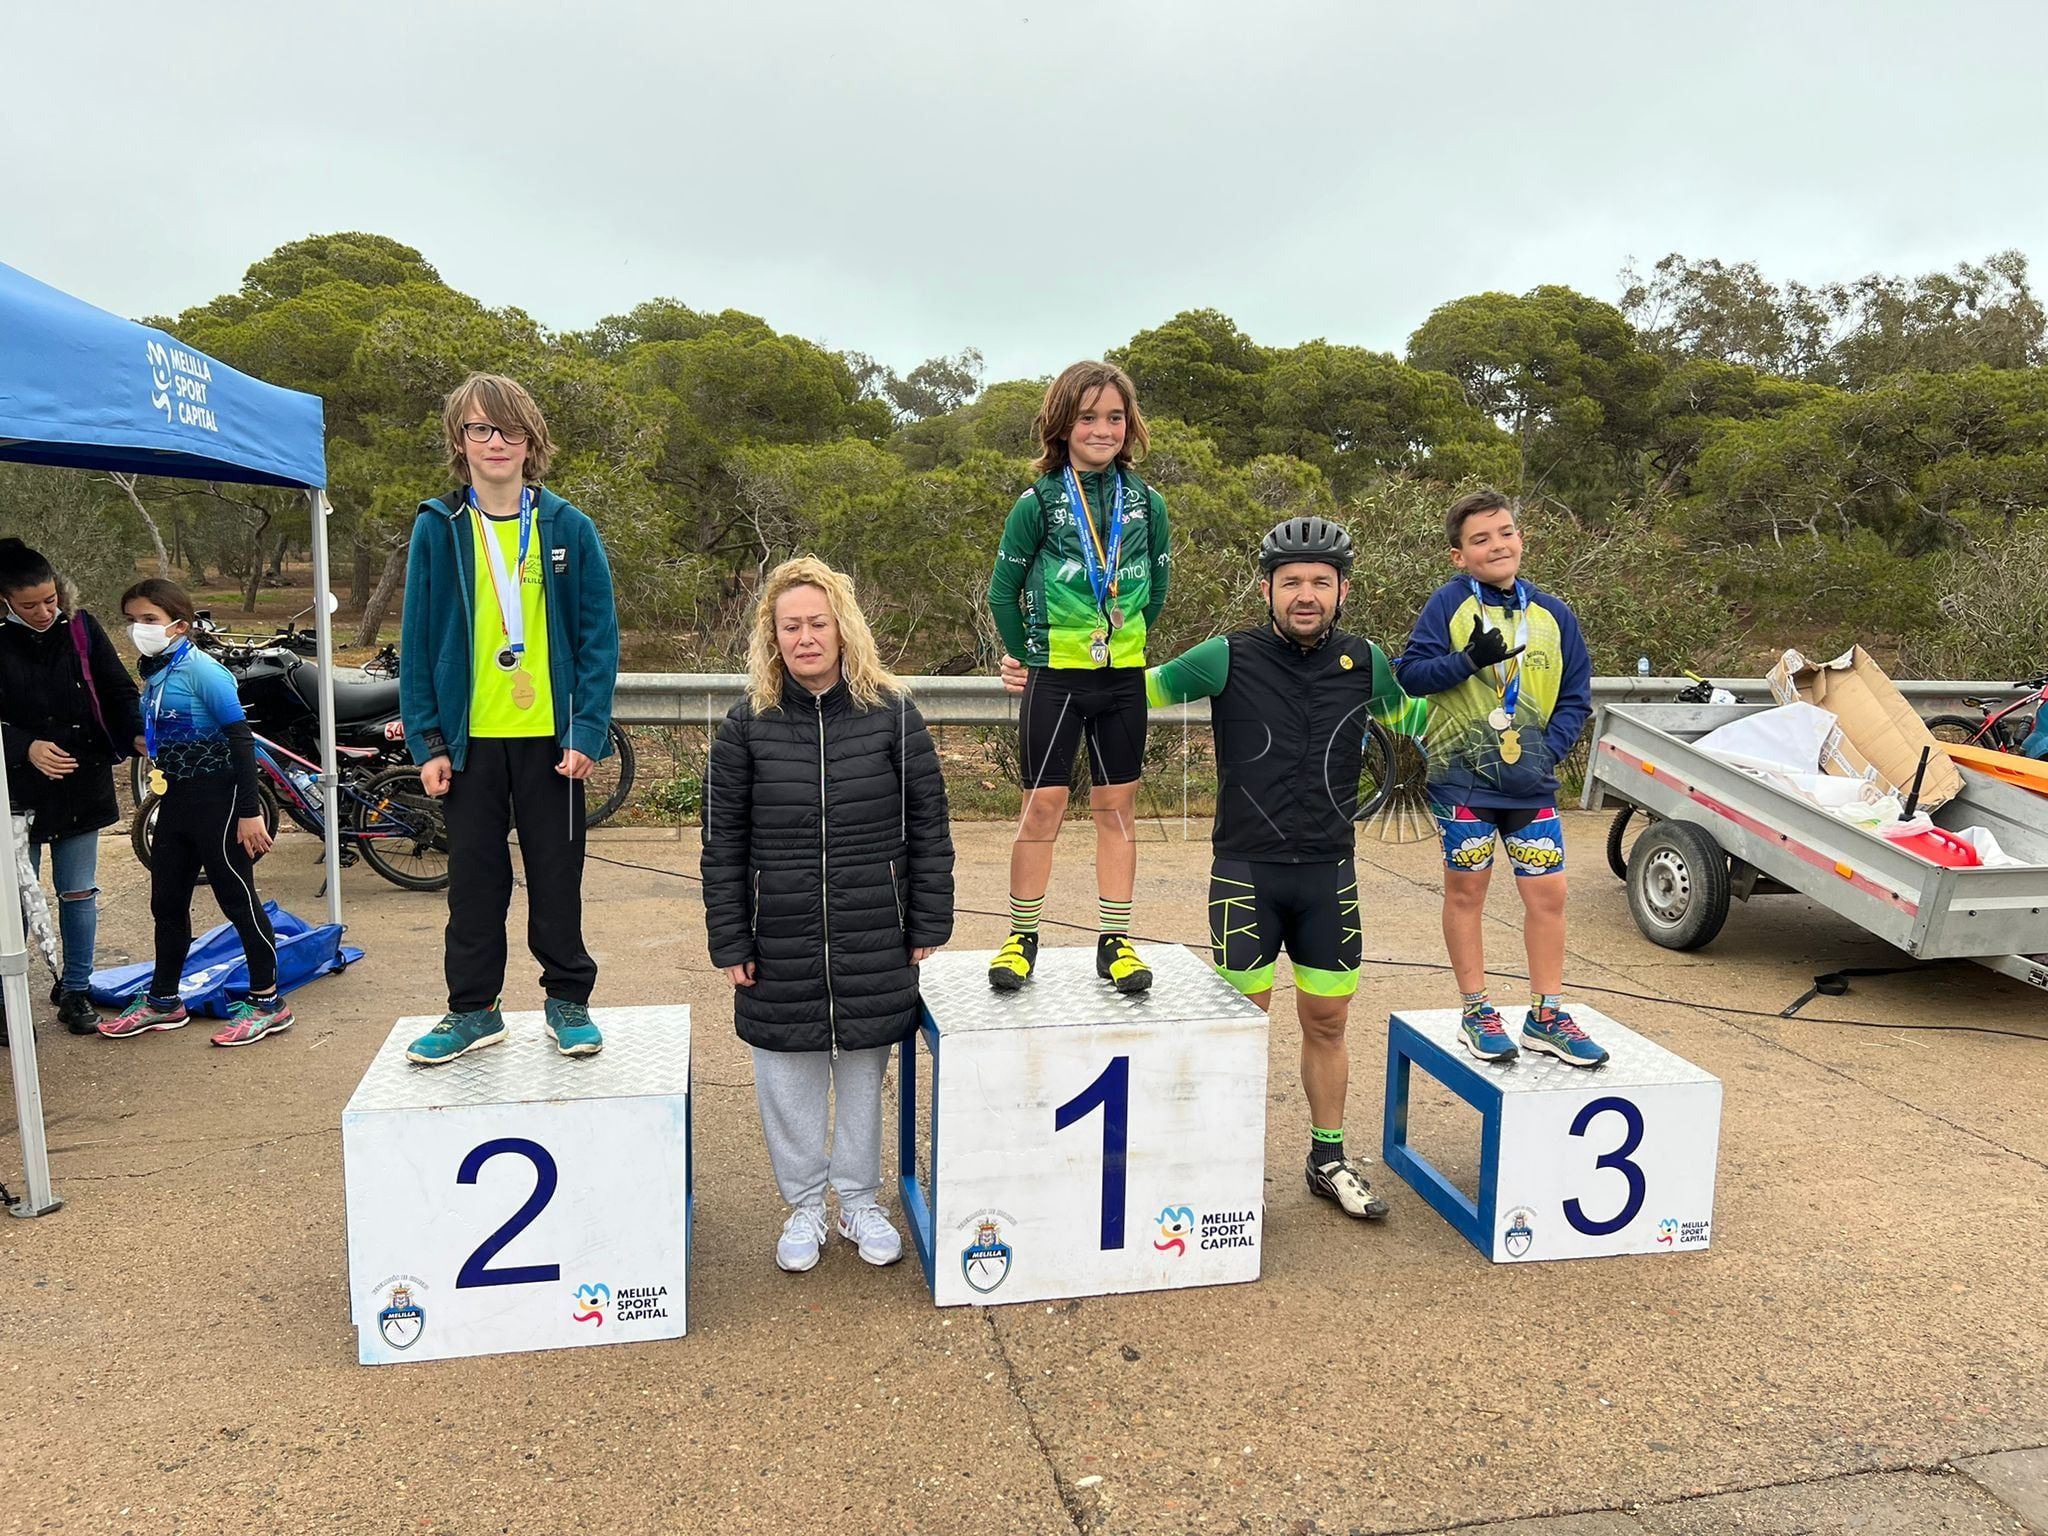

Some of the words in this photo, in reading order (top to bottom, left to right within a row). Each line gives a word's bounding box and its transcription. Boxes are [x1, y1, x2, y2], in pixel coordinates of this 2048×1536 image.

[169, 347, 213, 382] MELILLA
[174, 374, 207, 404] SPORT
[178, 401, 219, 432] CAPITAL
[1055, 1056, 1129, 1251] 1
[1563, 1096, 1646, 1236] 3
[456, 1138, 560, 1289] 2
[1201, 1210, 1256, 1226] MELILLA
[1201, 1224, 1245, 1238] SPORT
[1680, 1228, 1704, 1236] SPORT
[1681, 1221, 1710, 1230] MELILLA
[1200, 1235, 1255, 1250] CAPITAL
[1680, 1234, 1709, 1243] CAPITAL
[972, 1249, 1002, 1258] MELILLA
[617, 1286, 669, 1299] MELILLA
[617, 1298, 659, 1311] SPORT
[387, 1311, 416, 1319] MELILLA
[617, 1308, 669, 1322] CAPITAL
